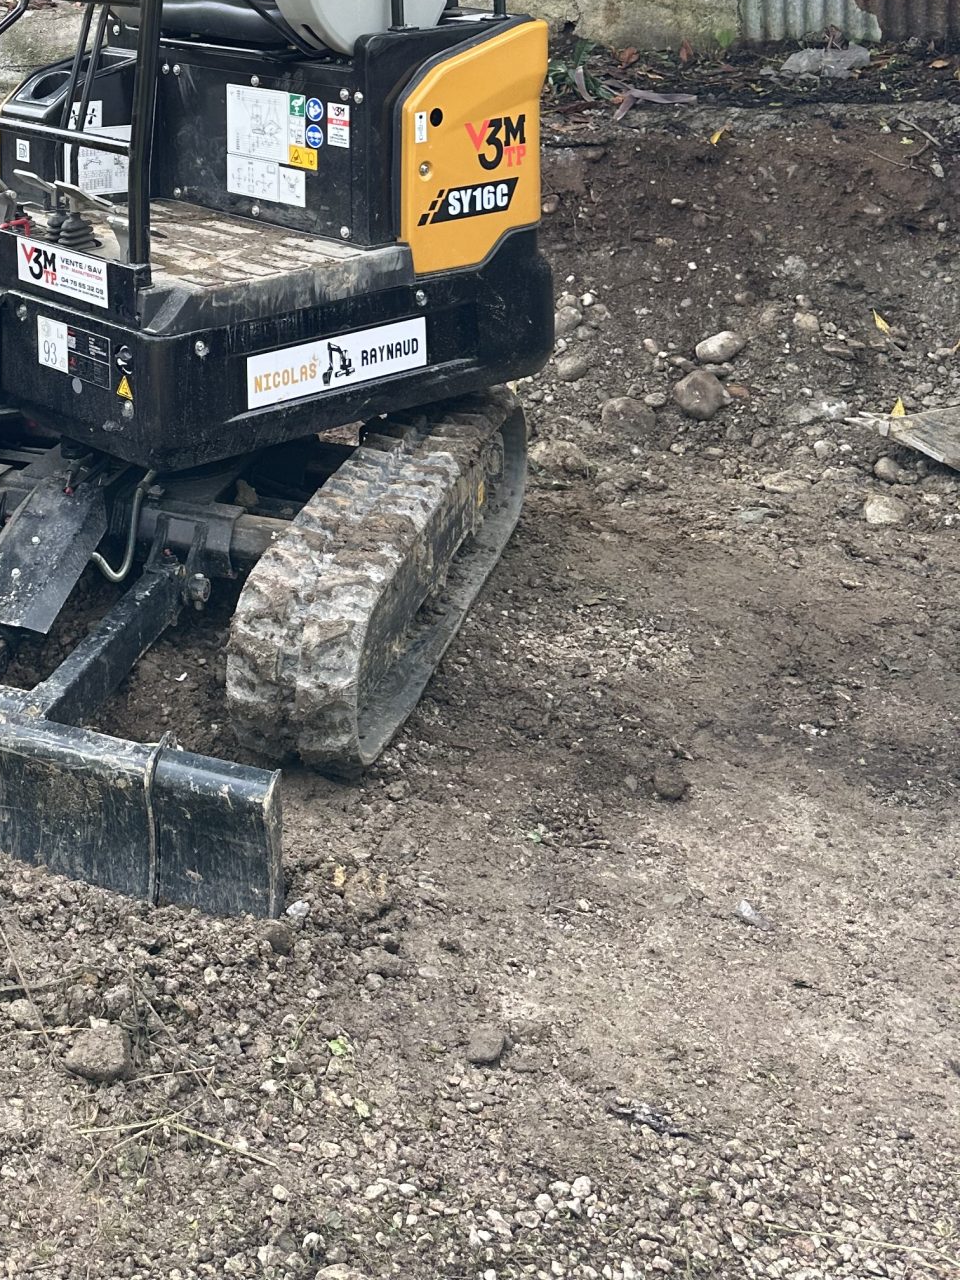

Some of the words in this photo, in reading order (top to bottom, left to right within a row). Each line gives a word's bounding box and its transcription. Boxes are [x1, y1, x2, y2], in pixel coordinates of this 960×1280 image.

[464, 114, 526, 170] V3M
[504, 145, 526, 167] TP
[448, 183, 509, 216] SY16C
[21, 243, 57, 280] V3M
[60, 257, 83, 270] VENTE
[87, 264, 103, 275] SAV
[43, 269, 57, 285] TP
[43, 340, 58, 365] 93
[254, 362, 318, 394] NICOLAS
[361, 337, 419, 367] RAYNAUD
